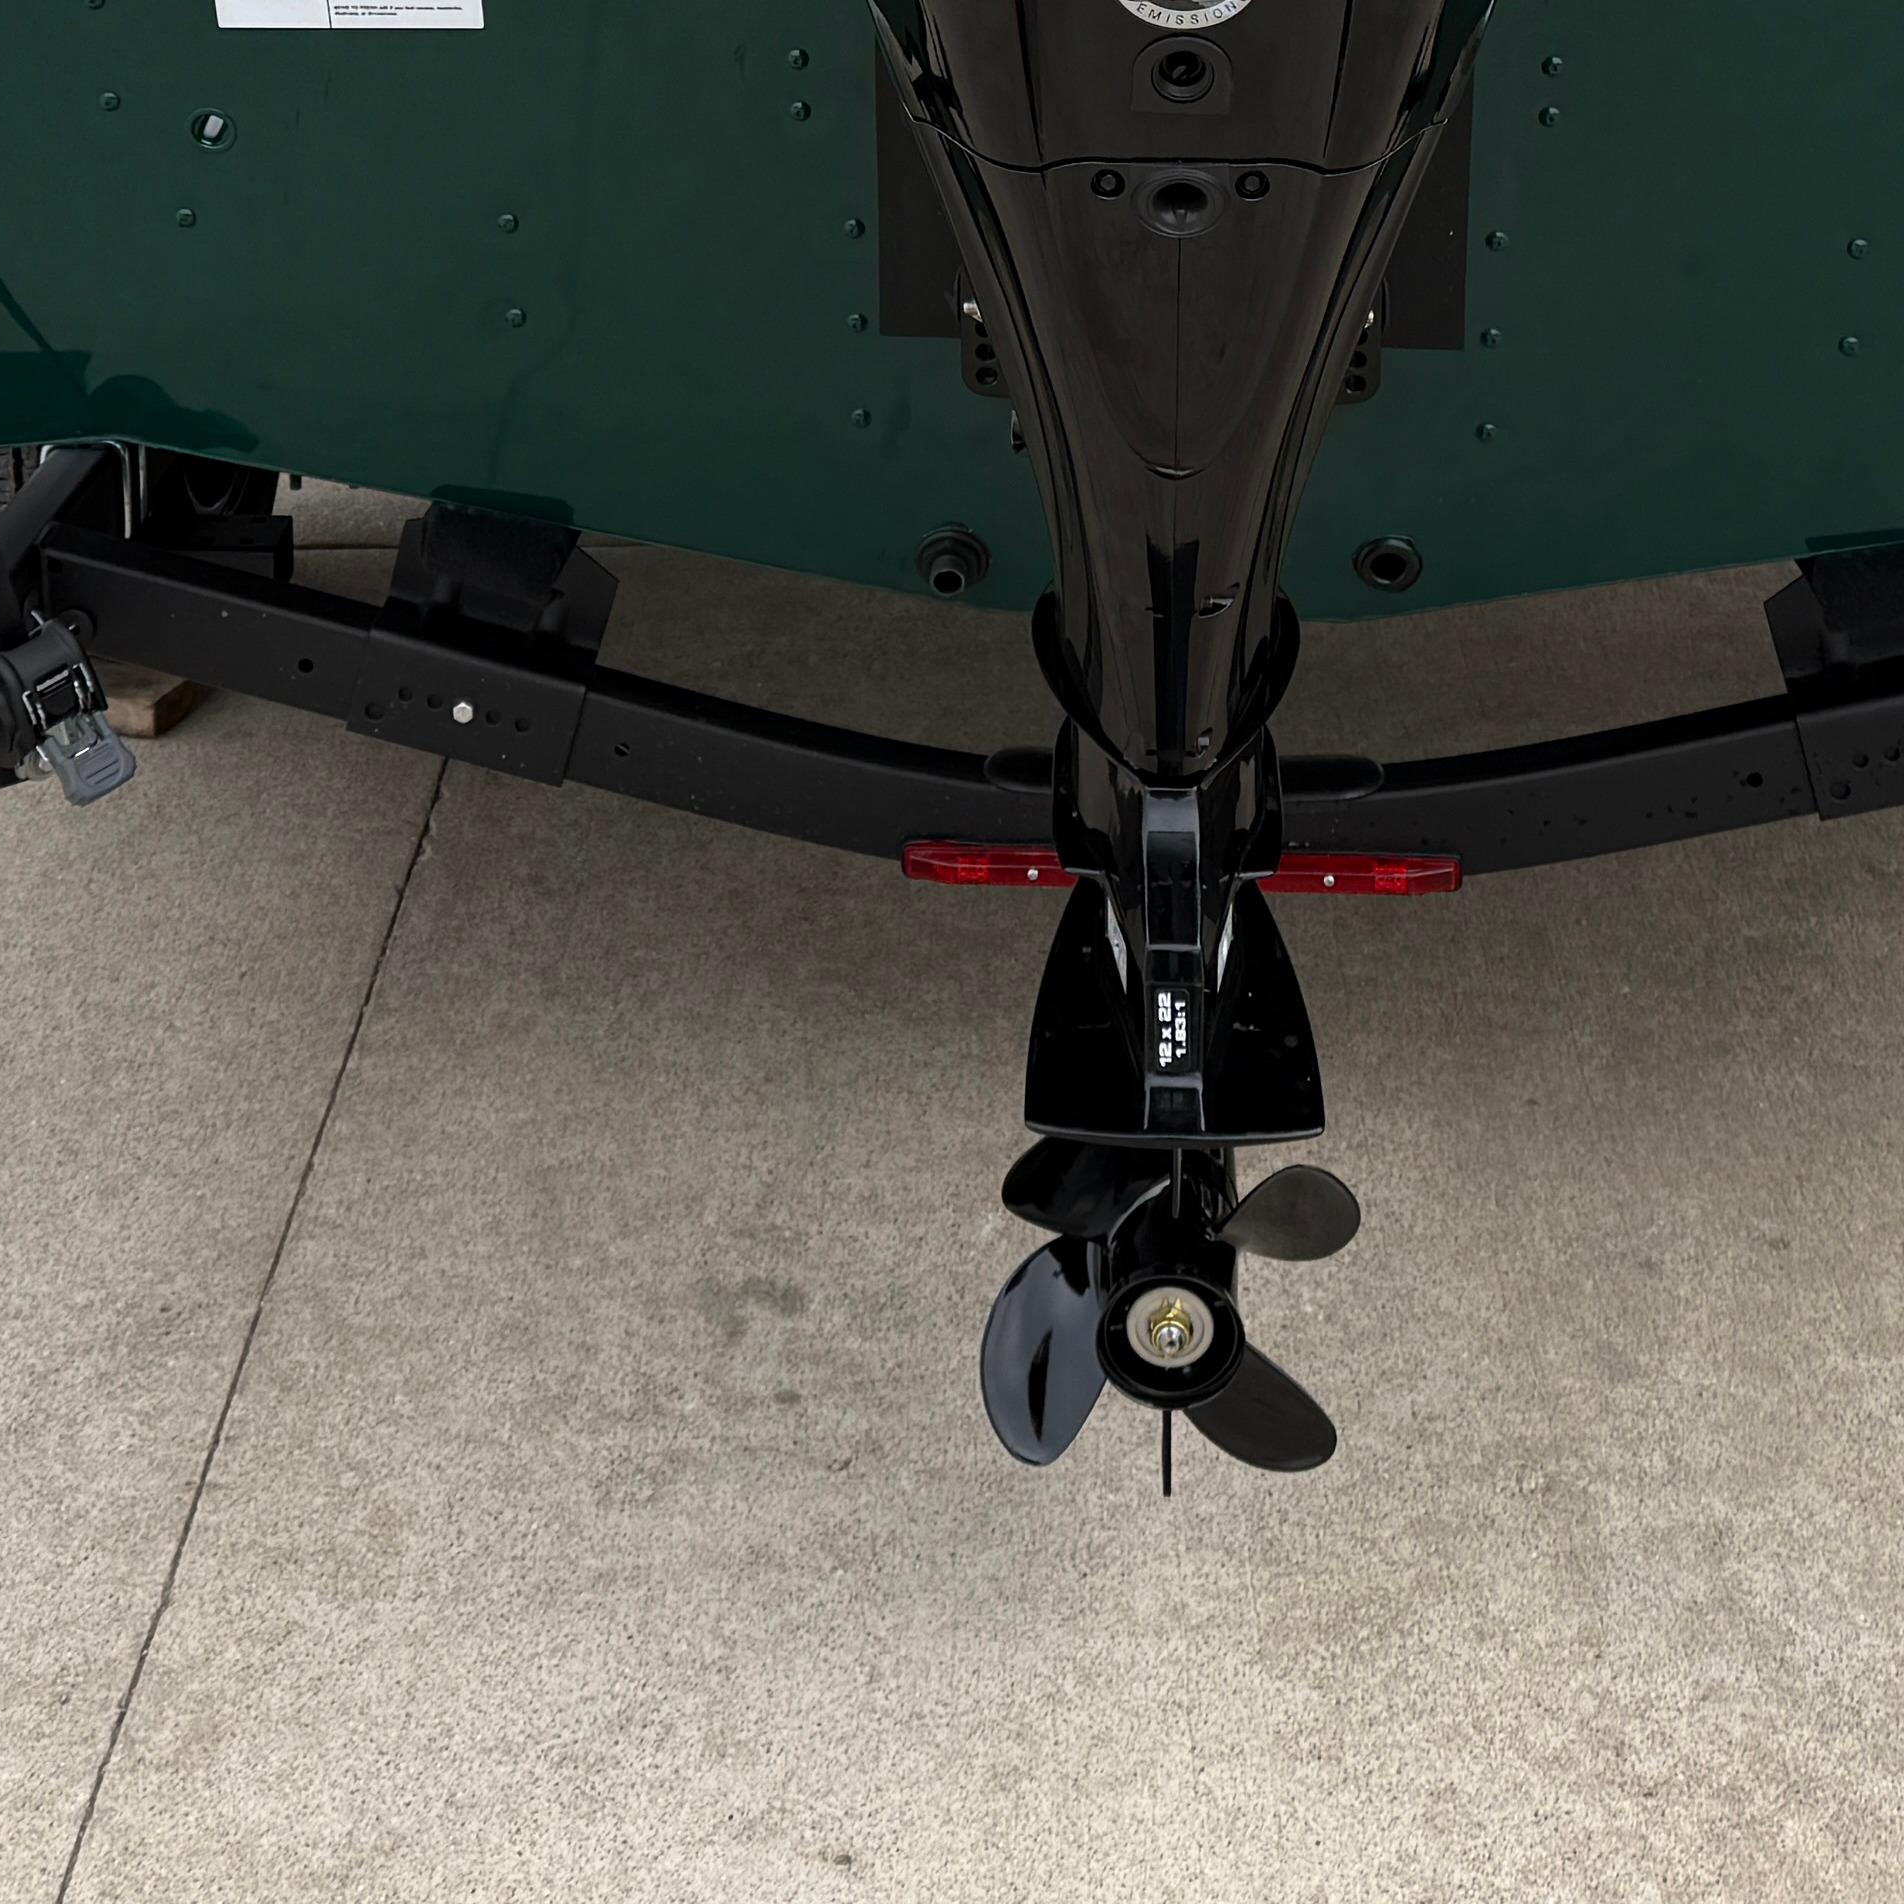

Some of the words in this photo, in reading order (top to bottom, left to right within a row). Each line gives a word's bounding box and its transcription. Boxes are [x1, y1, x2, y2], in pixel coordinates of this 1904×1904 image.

[1136, 2, 1238, 26] EMISSION
[1157, 992, 1172, 1022] 22
[1157, 1041, 1173, 1068] 12
